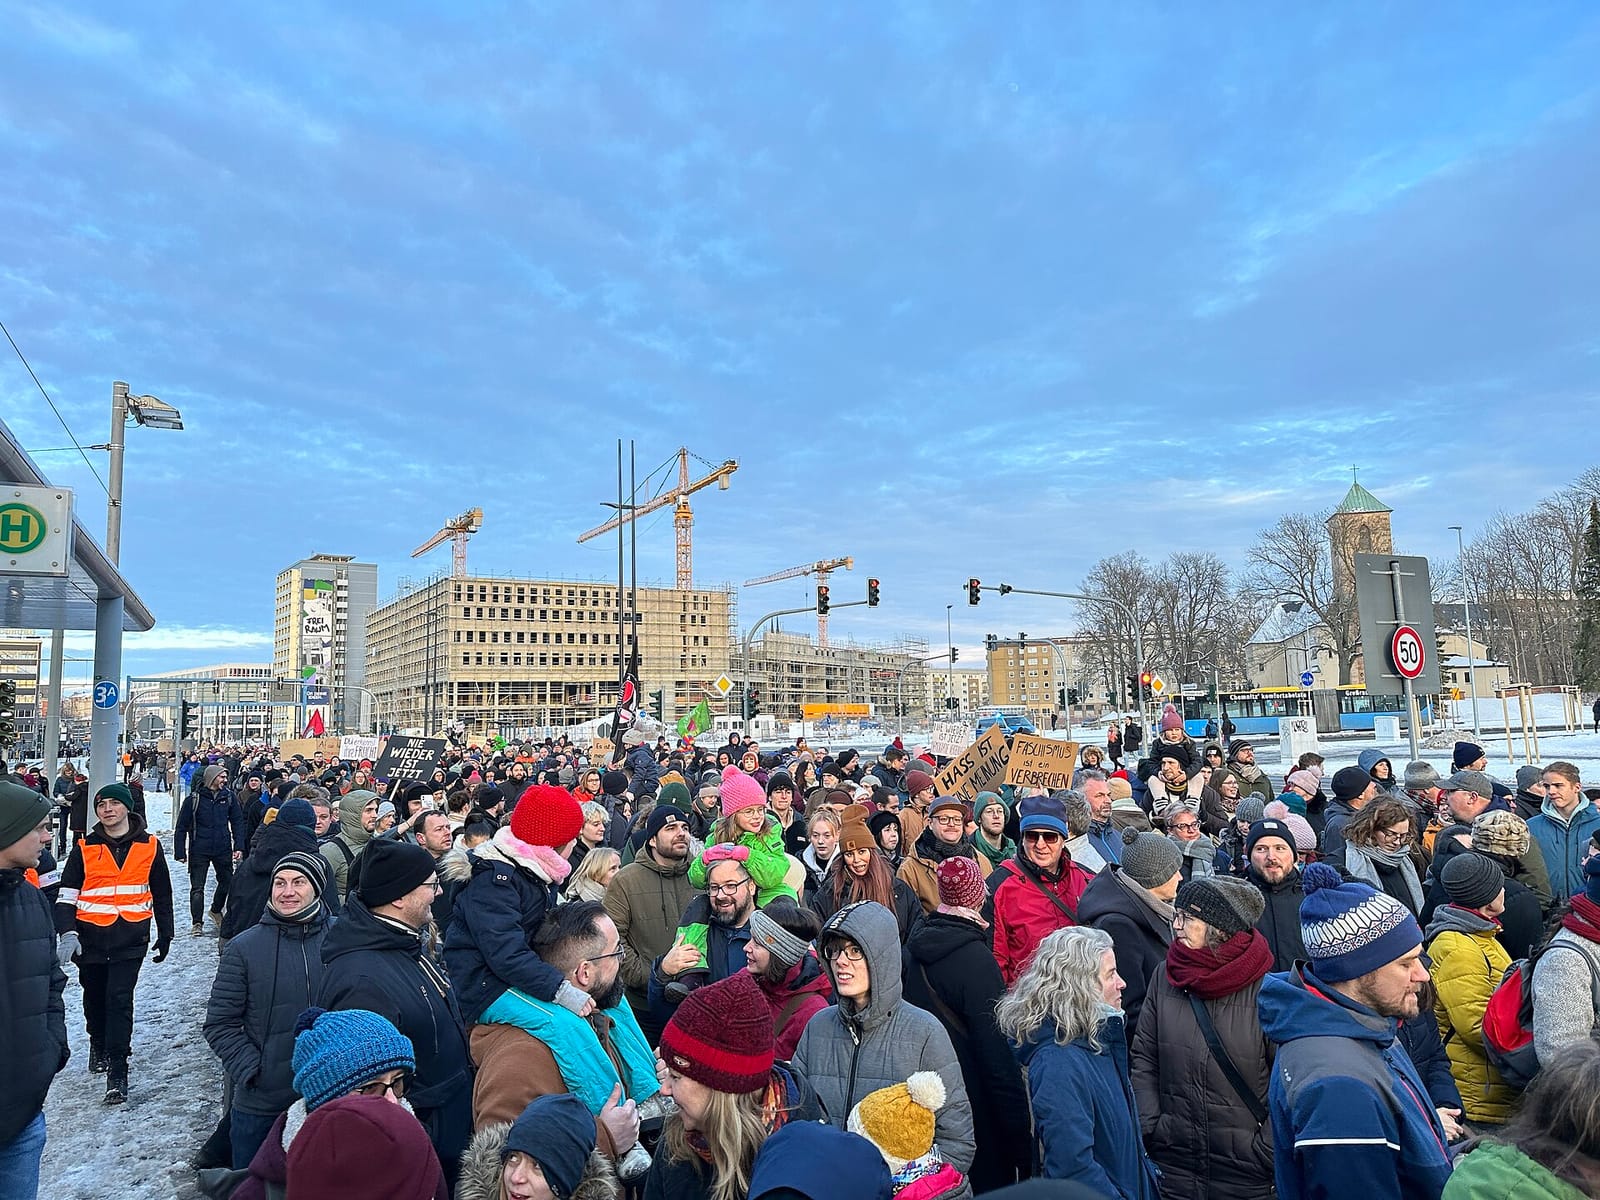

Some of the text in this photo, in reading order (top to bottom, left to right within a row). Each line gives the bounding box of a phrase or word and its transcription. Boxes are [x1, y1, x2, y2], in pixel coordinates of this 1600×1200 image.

[1, 514, 30, 543] H
[305, 624, 330, 634] RAUM
[1400, 640, 1418, 664] 50
[407, 738, 426, 748] NIE
[1016, 740, 1072, 759] FASCHISMUS
[390, 747, 435, 761] WIEDER
[400, 758, 419, 769] IST
[941, 752, 975, 791] HASS
[977, 735, 993, 758] IST
[969, 744, 1010, 793] MEINUNG
[1023, 759, 1050, 769] ist ein
[387, 767, 423, 779] JETZT
[1011, 767, 1070, 789] VERBRECHEN
